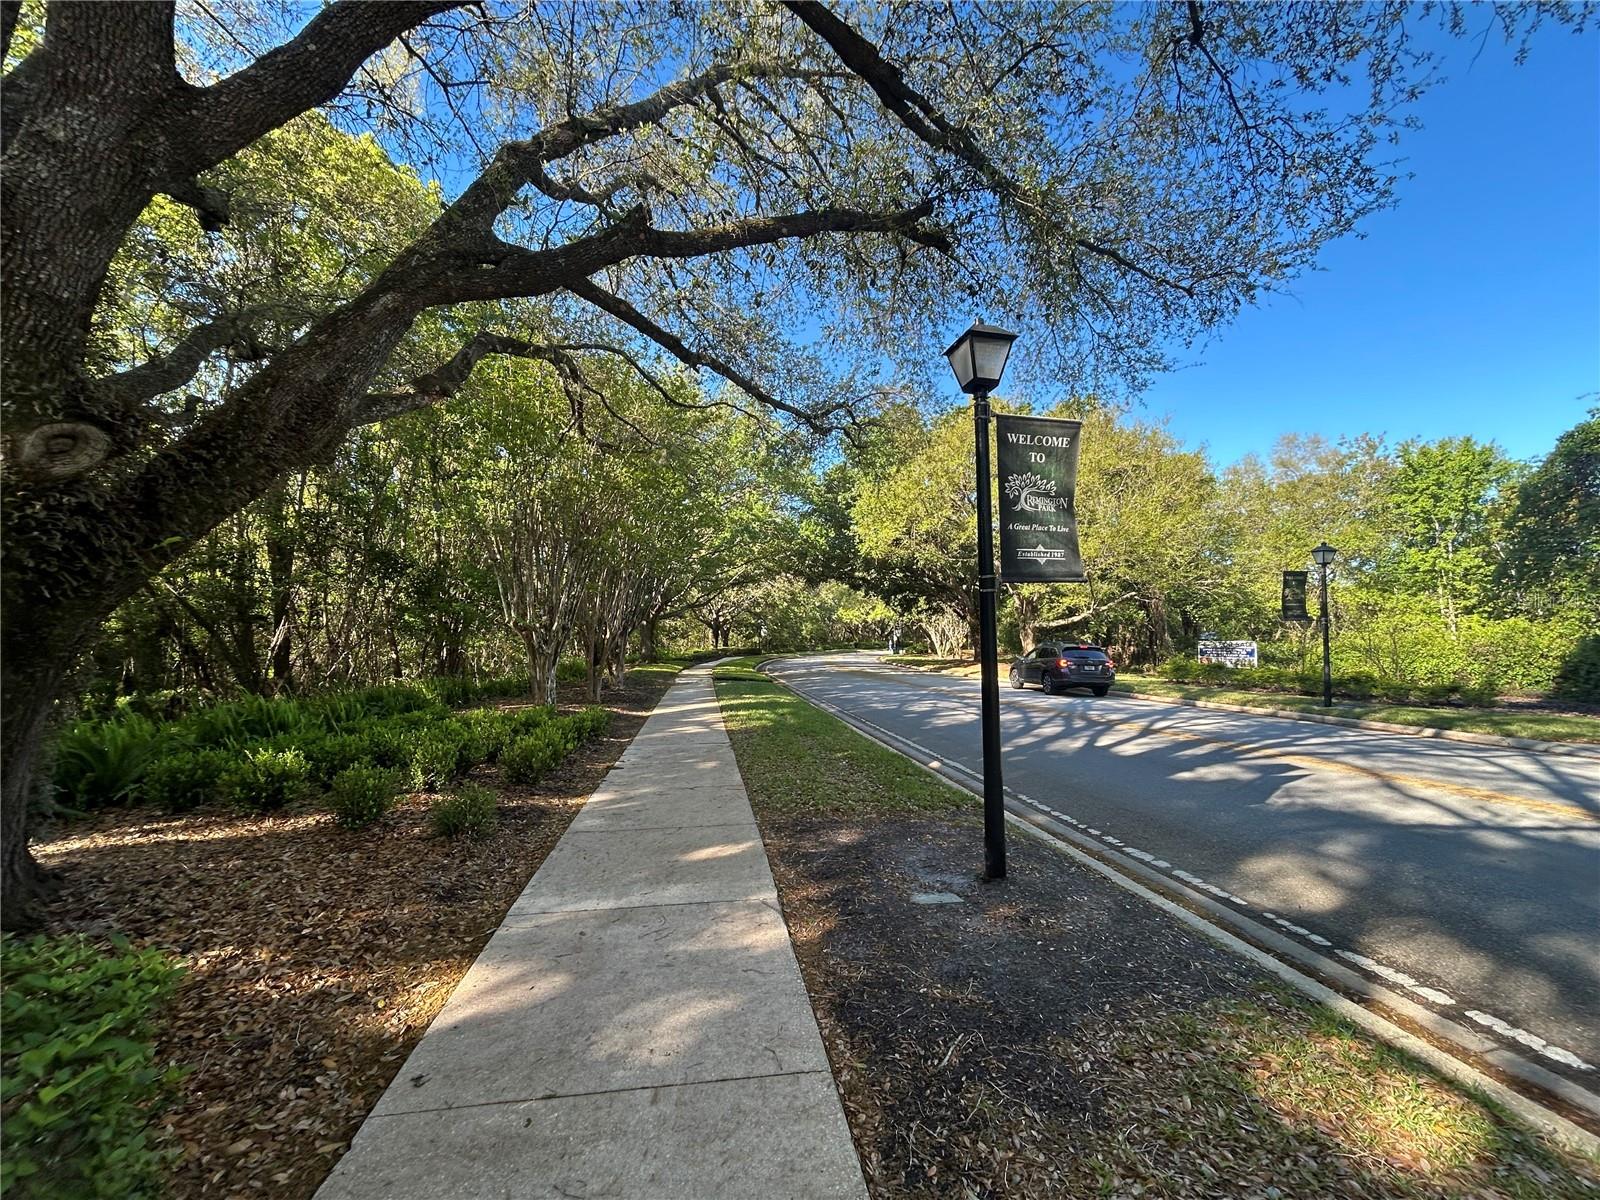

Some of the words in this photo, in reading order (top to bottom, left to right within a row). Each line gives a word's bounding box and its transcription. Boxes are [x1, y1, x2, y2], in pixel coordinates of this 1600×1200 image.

[1007, 433, 1070, 448] WELCOME
[1029, 452, 1045, 463] TO
[1027, 495, 1068, 509] REMINGTON
[1038, 504, 1056, 512] PARK
[1013, 523, 1031, 531] Great
[1031, 523, 1048, 531] Place
[1057, 525, 1070, 533] Live
